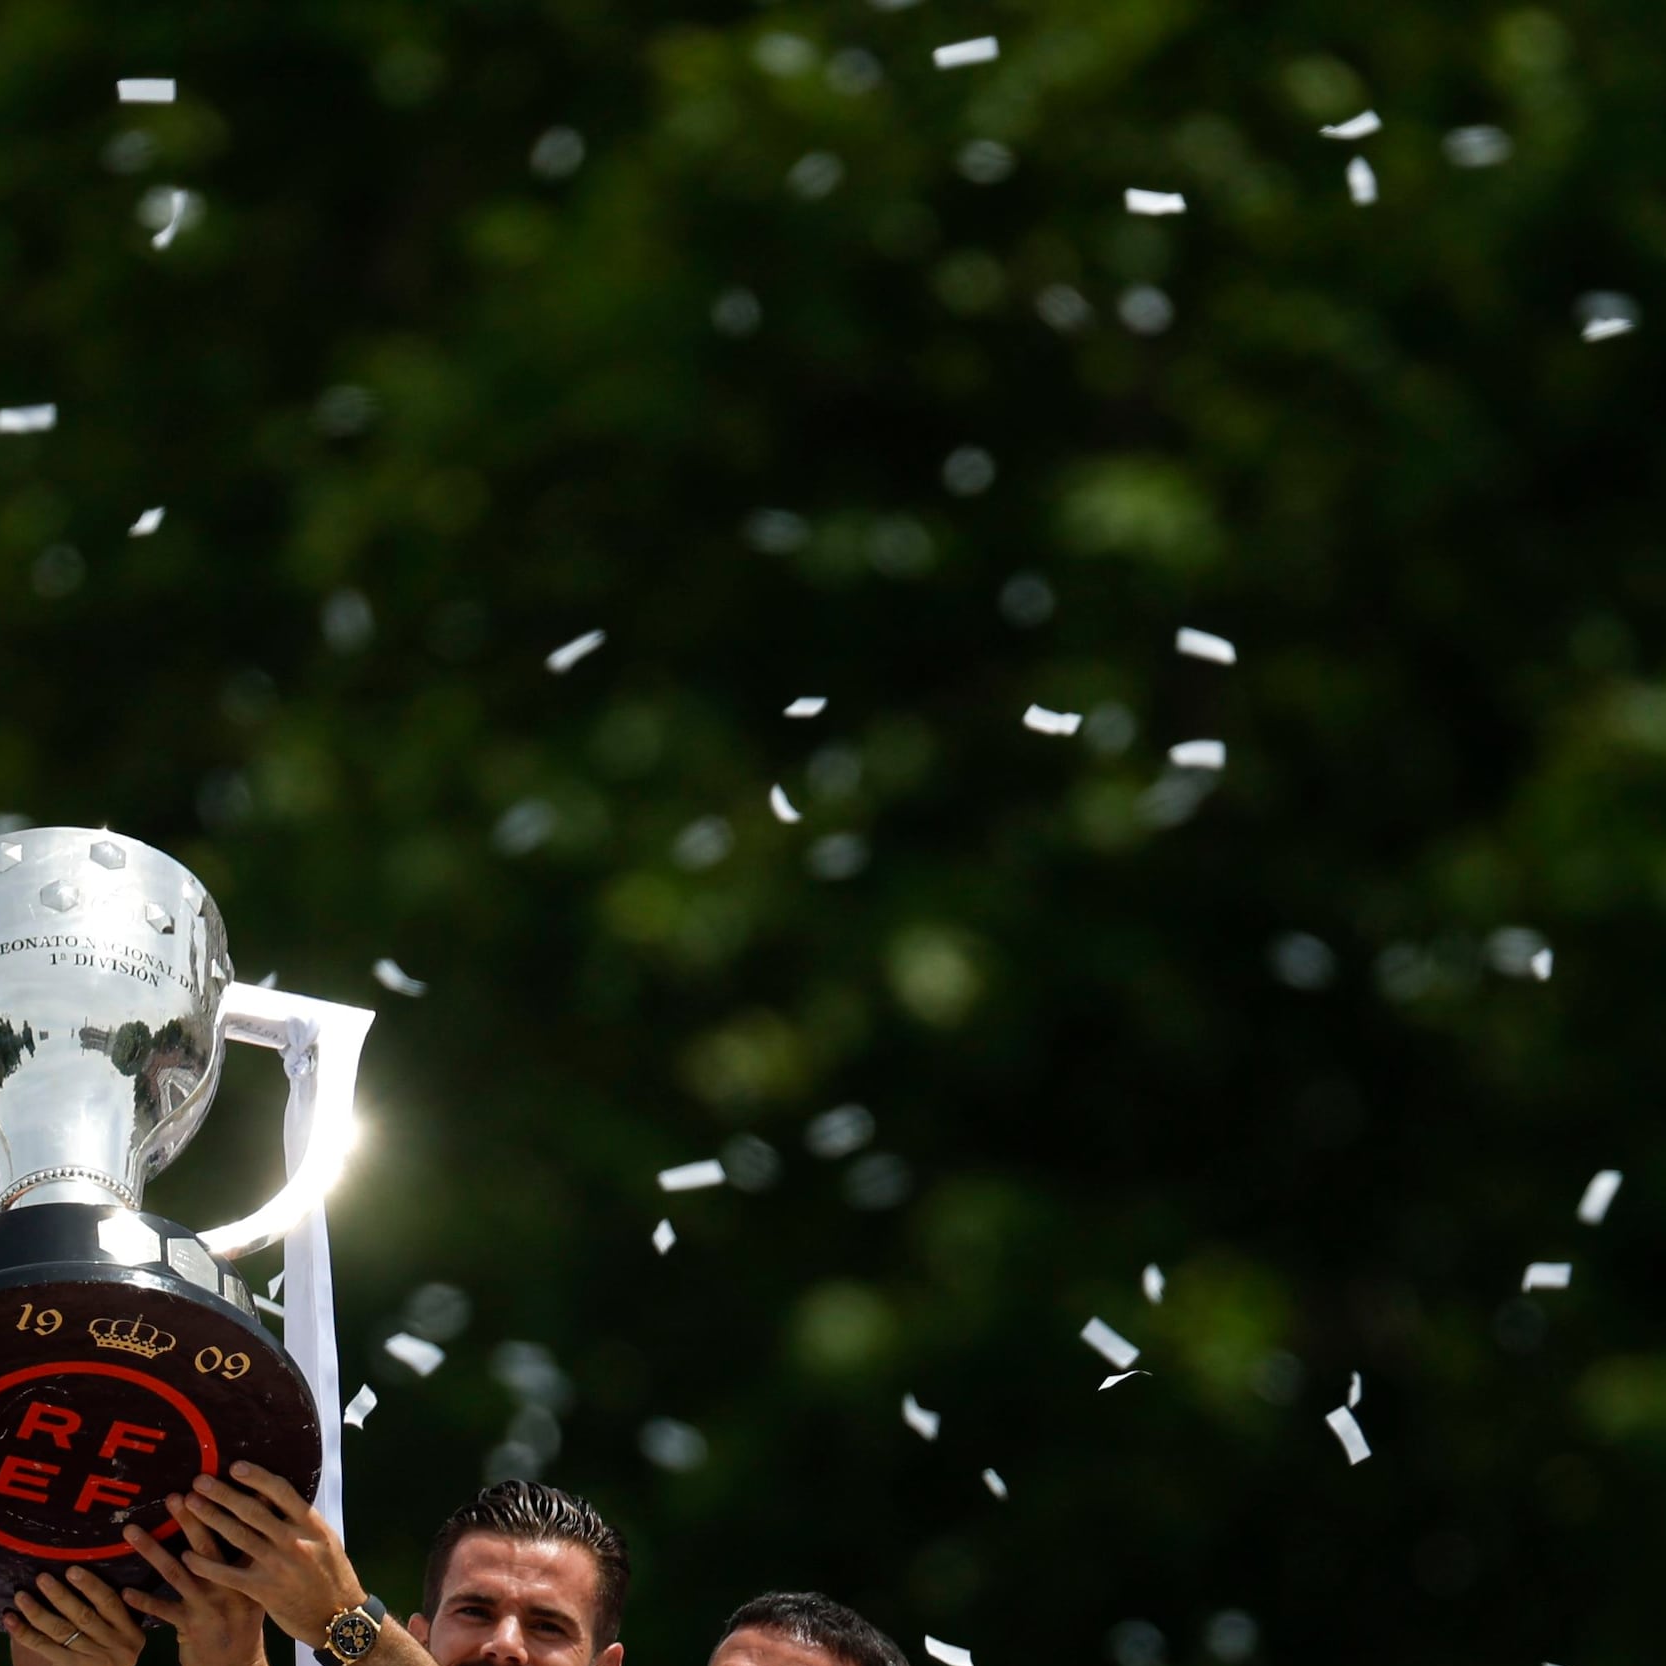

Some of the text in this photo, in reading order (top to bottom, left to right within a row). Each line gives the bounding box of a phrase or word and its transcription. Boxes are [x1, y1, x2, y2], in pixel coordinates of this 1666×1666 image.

[73, 953, 161, 988] DIVISIÓN
[15, 1302, 64, 1337] 19
[193, 1345, 251, 1380] 09
